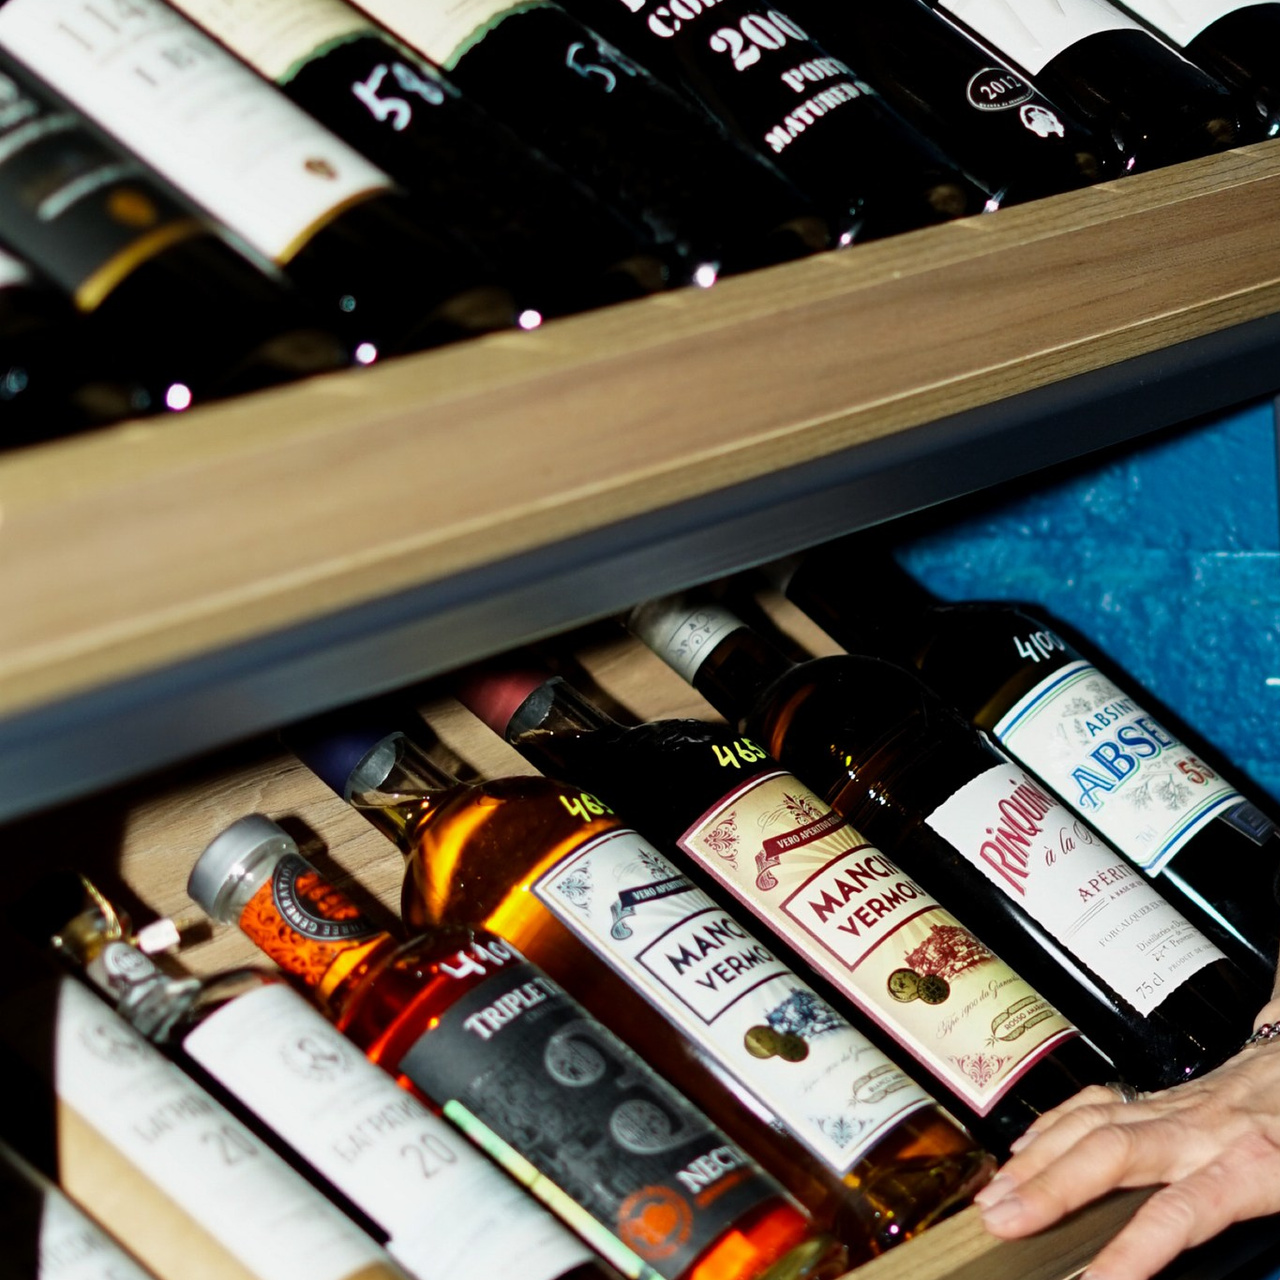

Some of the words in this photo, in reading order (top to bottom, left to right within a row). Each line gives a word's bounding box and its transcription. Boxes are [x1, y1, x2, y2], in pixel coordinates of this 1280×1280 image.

[709, 10, 809, 71] 200
[980, 75, 1022, 100] 2012
[1070, 716, 1174, 810] ABSE
[776, 833, 801, 849] VERO
[1058, 826, 1076, 855] la
[631, 886, 657, 901] VERO
[1135, 980, 1155, 1000] 75
[1152, 971, 1166, 987] cl
[463, 982, 548, 1041] TRIPLE
[1003, 1011, 1027, 1032] ROSSO
[202, 1123, 259, 1166] 20
[399, 1132, 458, 1179] 20
